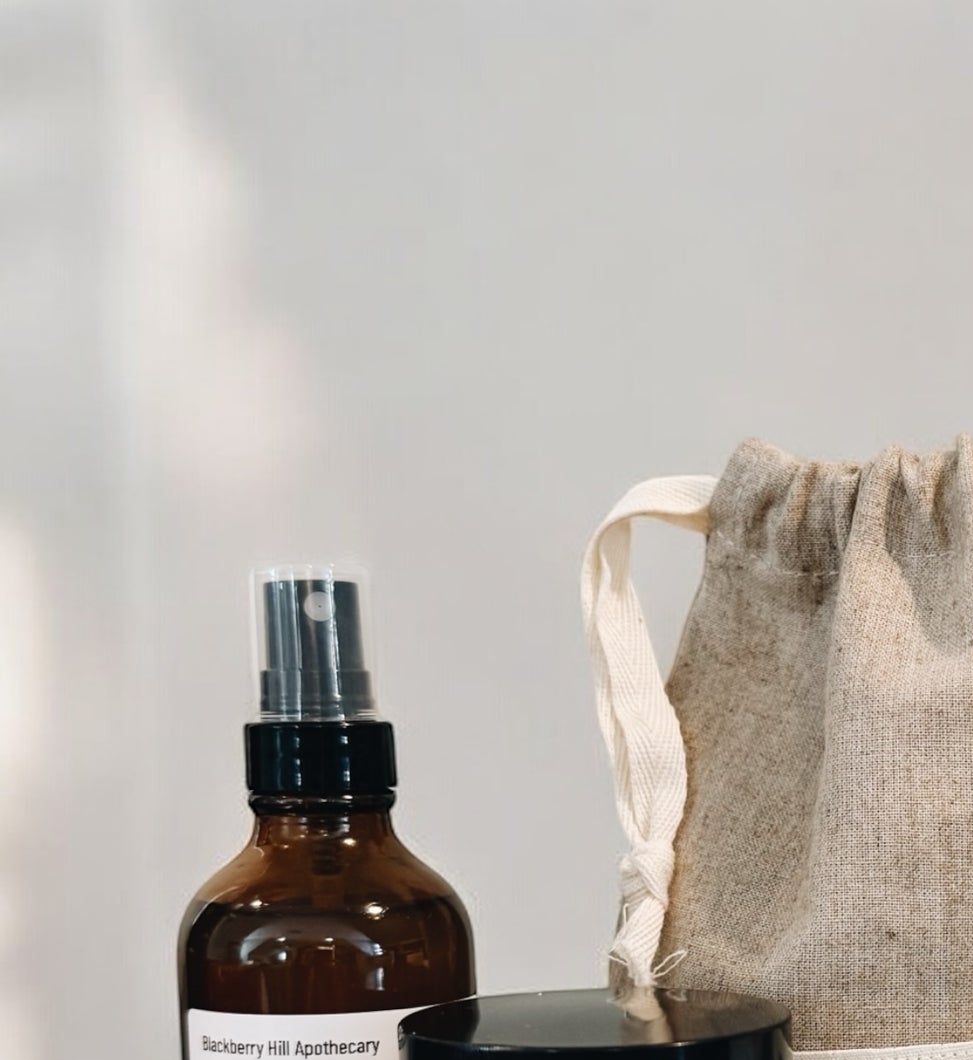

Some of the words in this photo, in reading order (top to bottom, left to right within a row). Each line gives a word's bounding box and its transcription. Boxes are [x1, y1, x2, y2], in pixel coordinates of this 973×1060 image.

[202, 1036, 264, 1059] Blackberry
[268, 1041, 290, 1056] Hill
[294, 1039, 380, 1059] Apothecary
